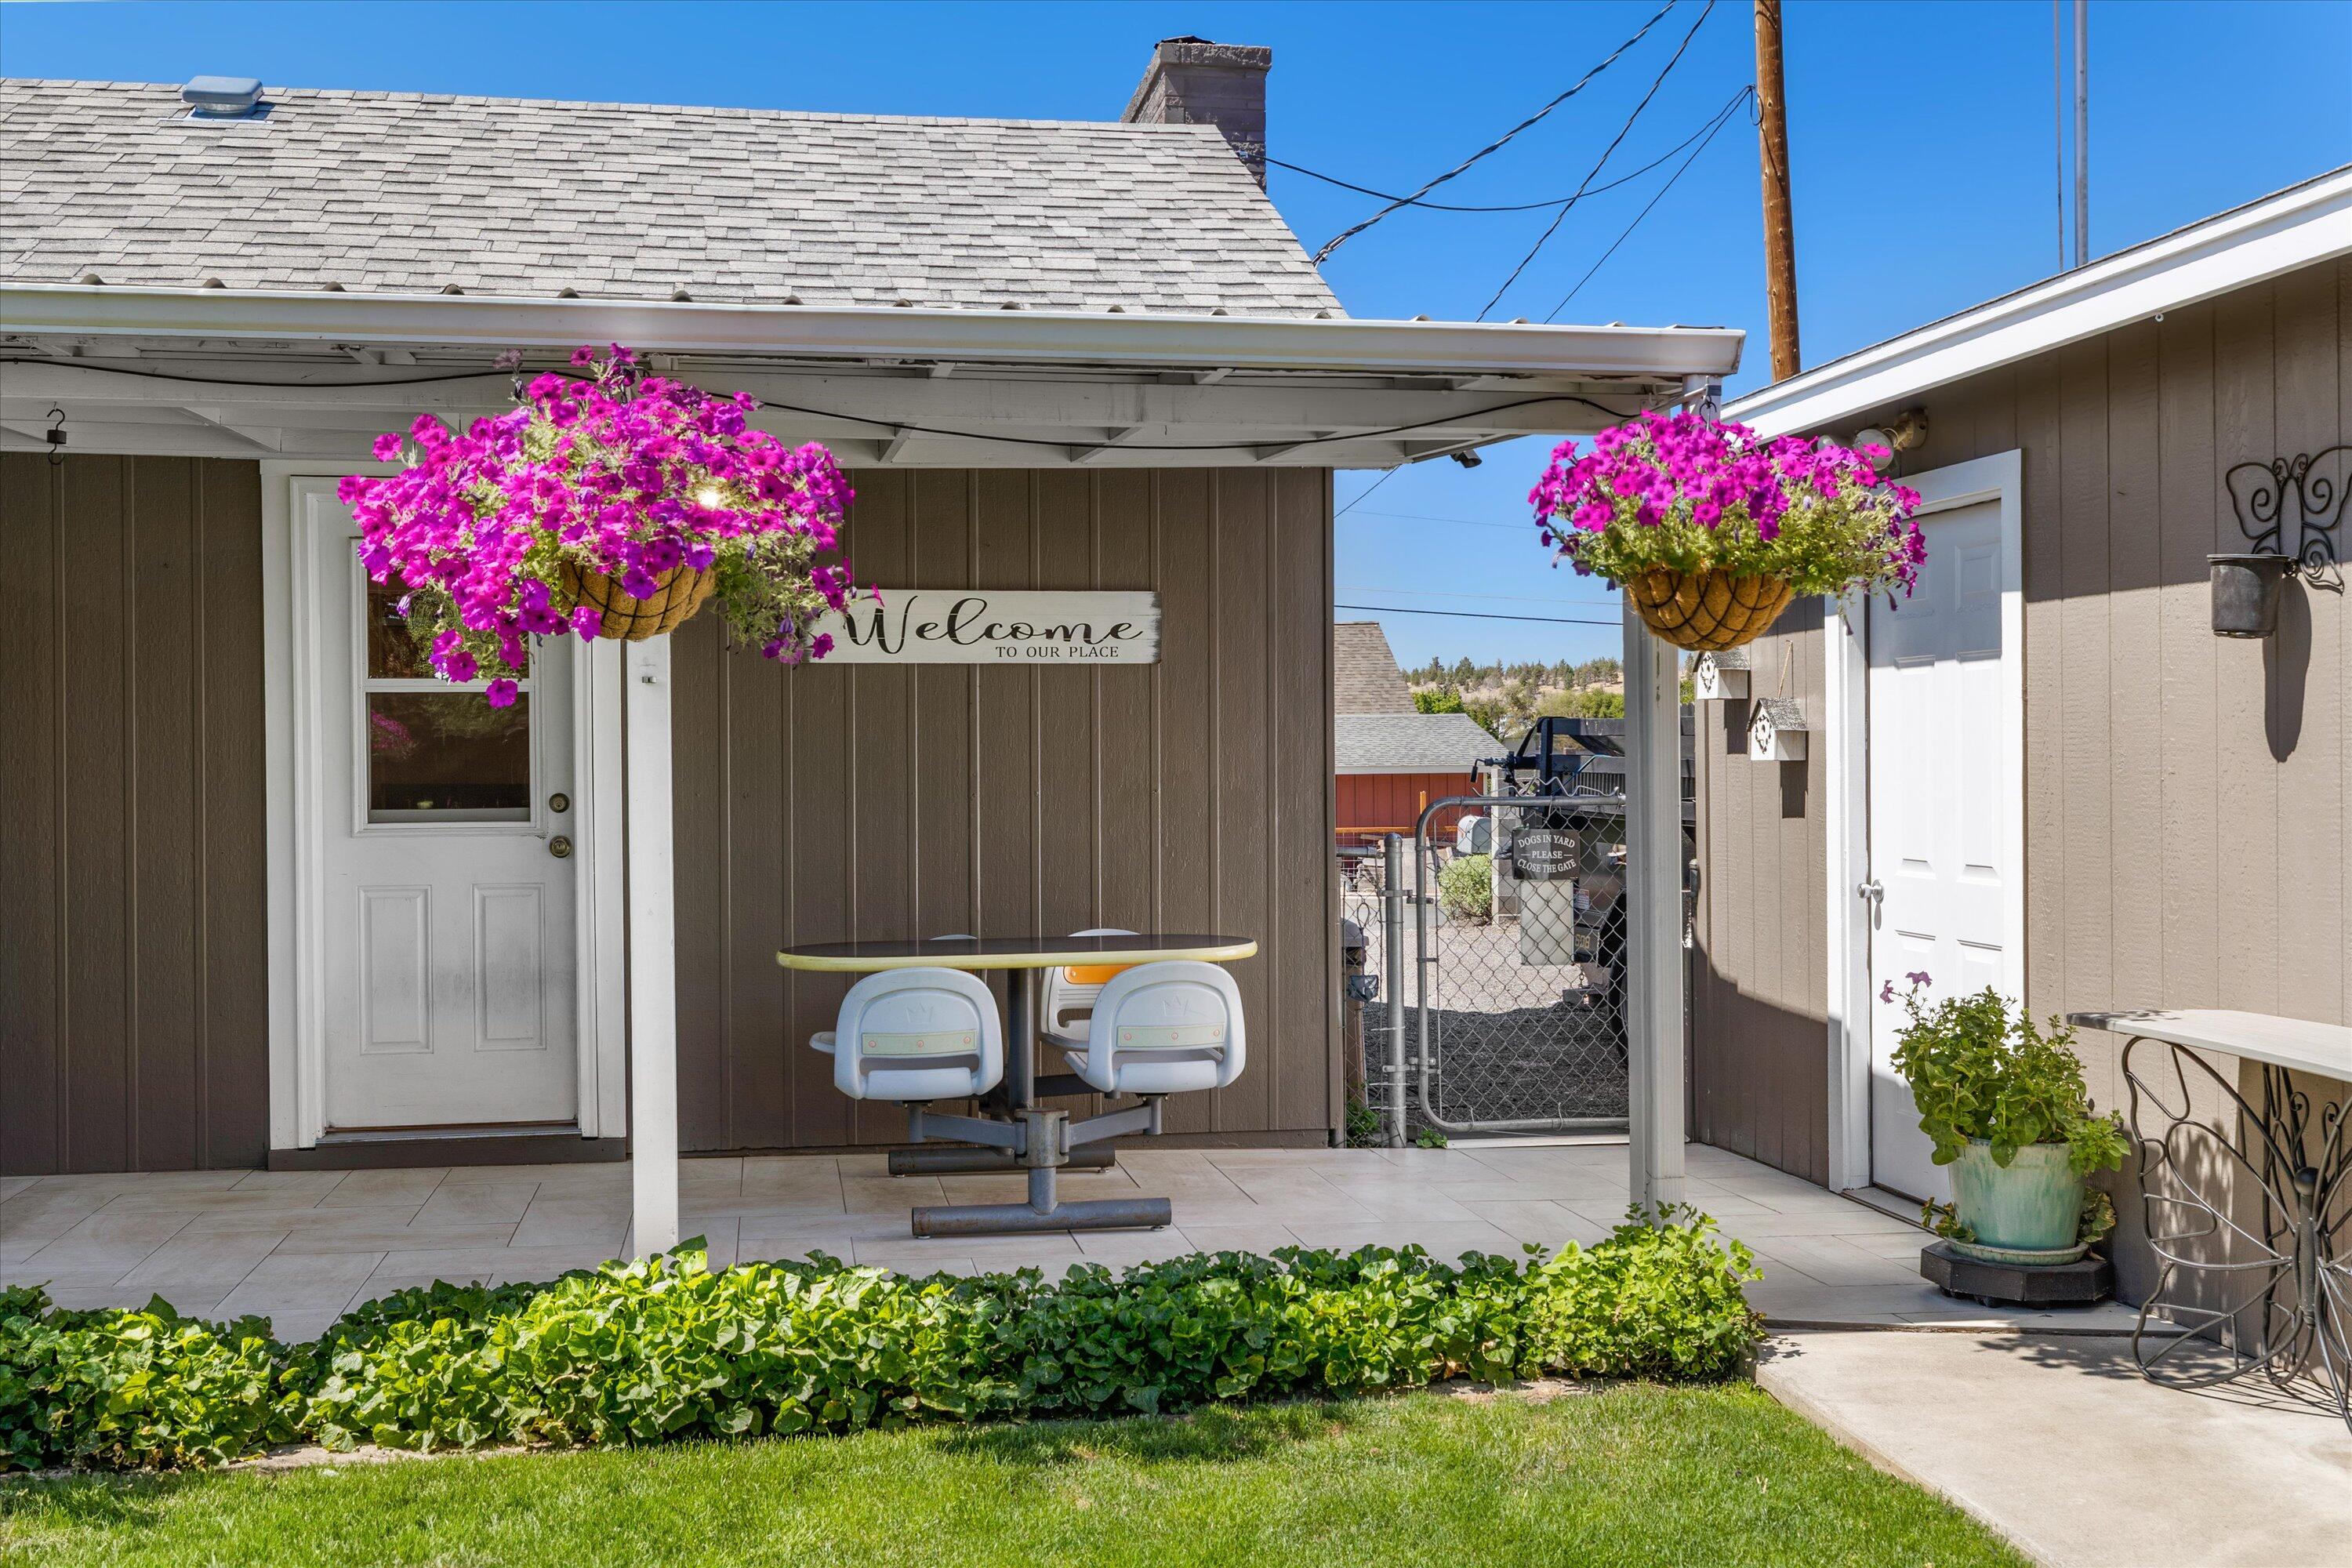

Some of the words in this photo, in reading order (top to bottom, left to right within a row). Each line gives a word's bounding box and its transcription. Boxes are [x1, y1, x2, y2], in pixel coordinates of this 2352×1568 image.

[844, 595, 1143, 654] Welcome
[995, 646, 1017, 658] TO
[1026, 646, 1060, 658] OUR
[1069, 646, 1119, 658] PLACE
[1517, 835, 1541, 848] DOGS
[1542, 834, 1552, 843] IN
[1553, 835, 1575, 848] YARD
[1531, 851, 1563, 859] PLEASE
[1517, 858, 1541, 873] CLOSE
[1542, 864, 1557, 873] THE
[1557, 858, 1577, 872] GATE
